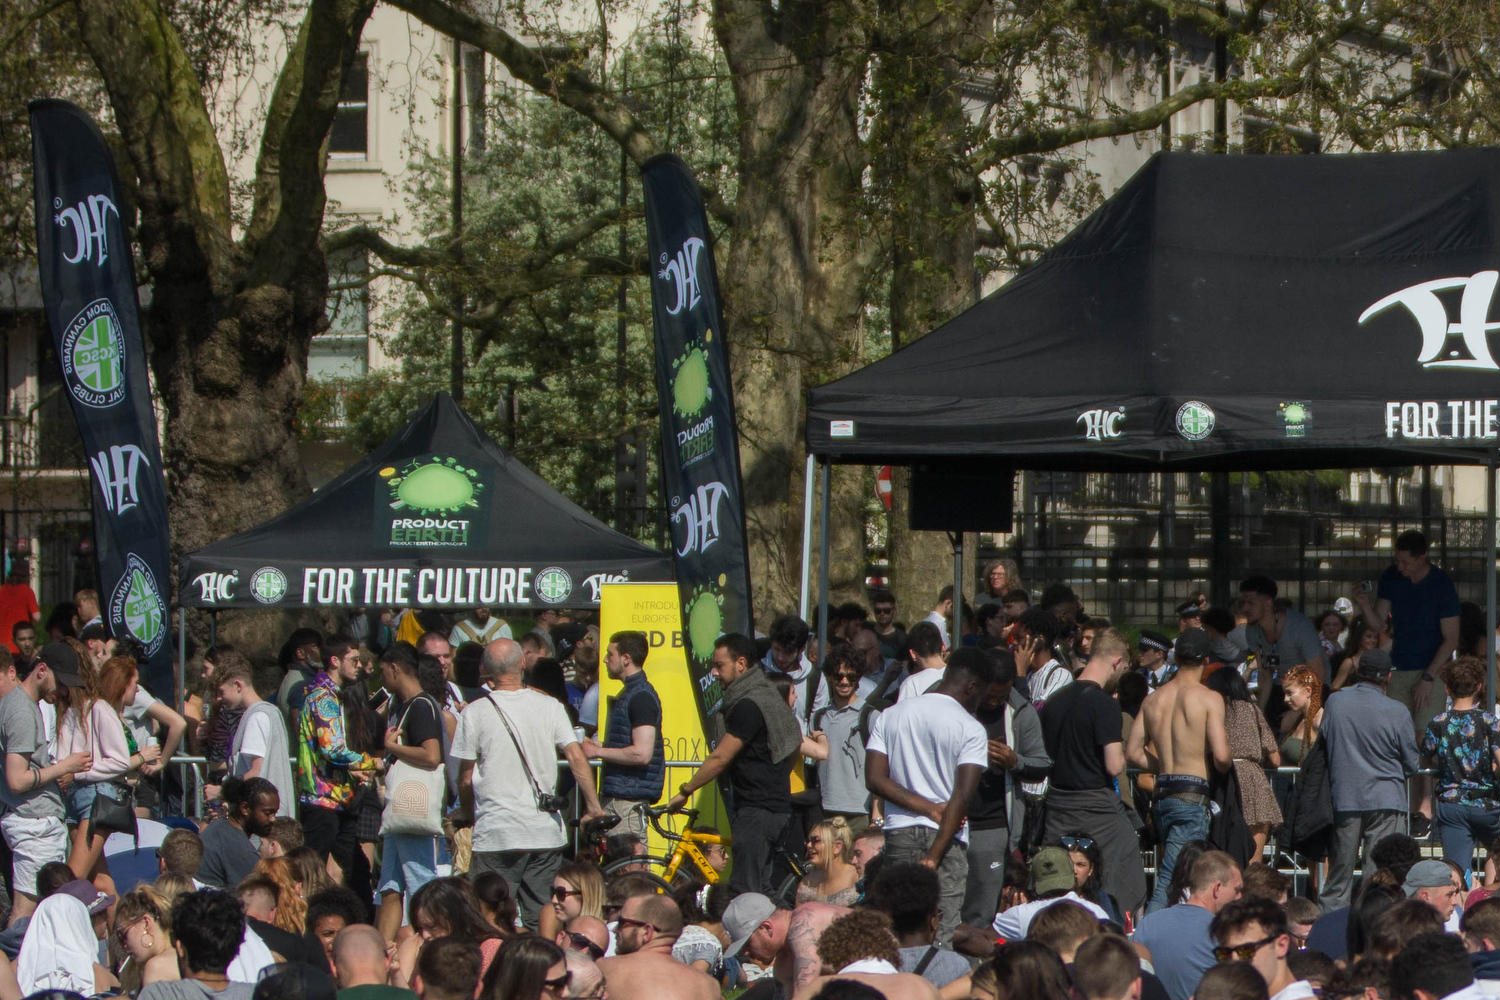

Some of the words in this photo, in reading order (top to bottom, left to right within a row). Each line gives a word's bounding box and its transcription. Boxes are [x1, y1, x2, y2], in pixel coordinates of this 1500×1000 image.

[1386, 402, 1439, 440] FOR
[1447, 400, 1498, 440] THE
[391, 528, 468, 542] EARTH
[392, 518, 470, 530] PRODUCT
[192, 570, 239, 603] THC
[302, 567, 354, 604] FOR
[362, 567, 409, 604] THE
[416, 567, 532, 604] CULTURE
